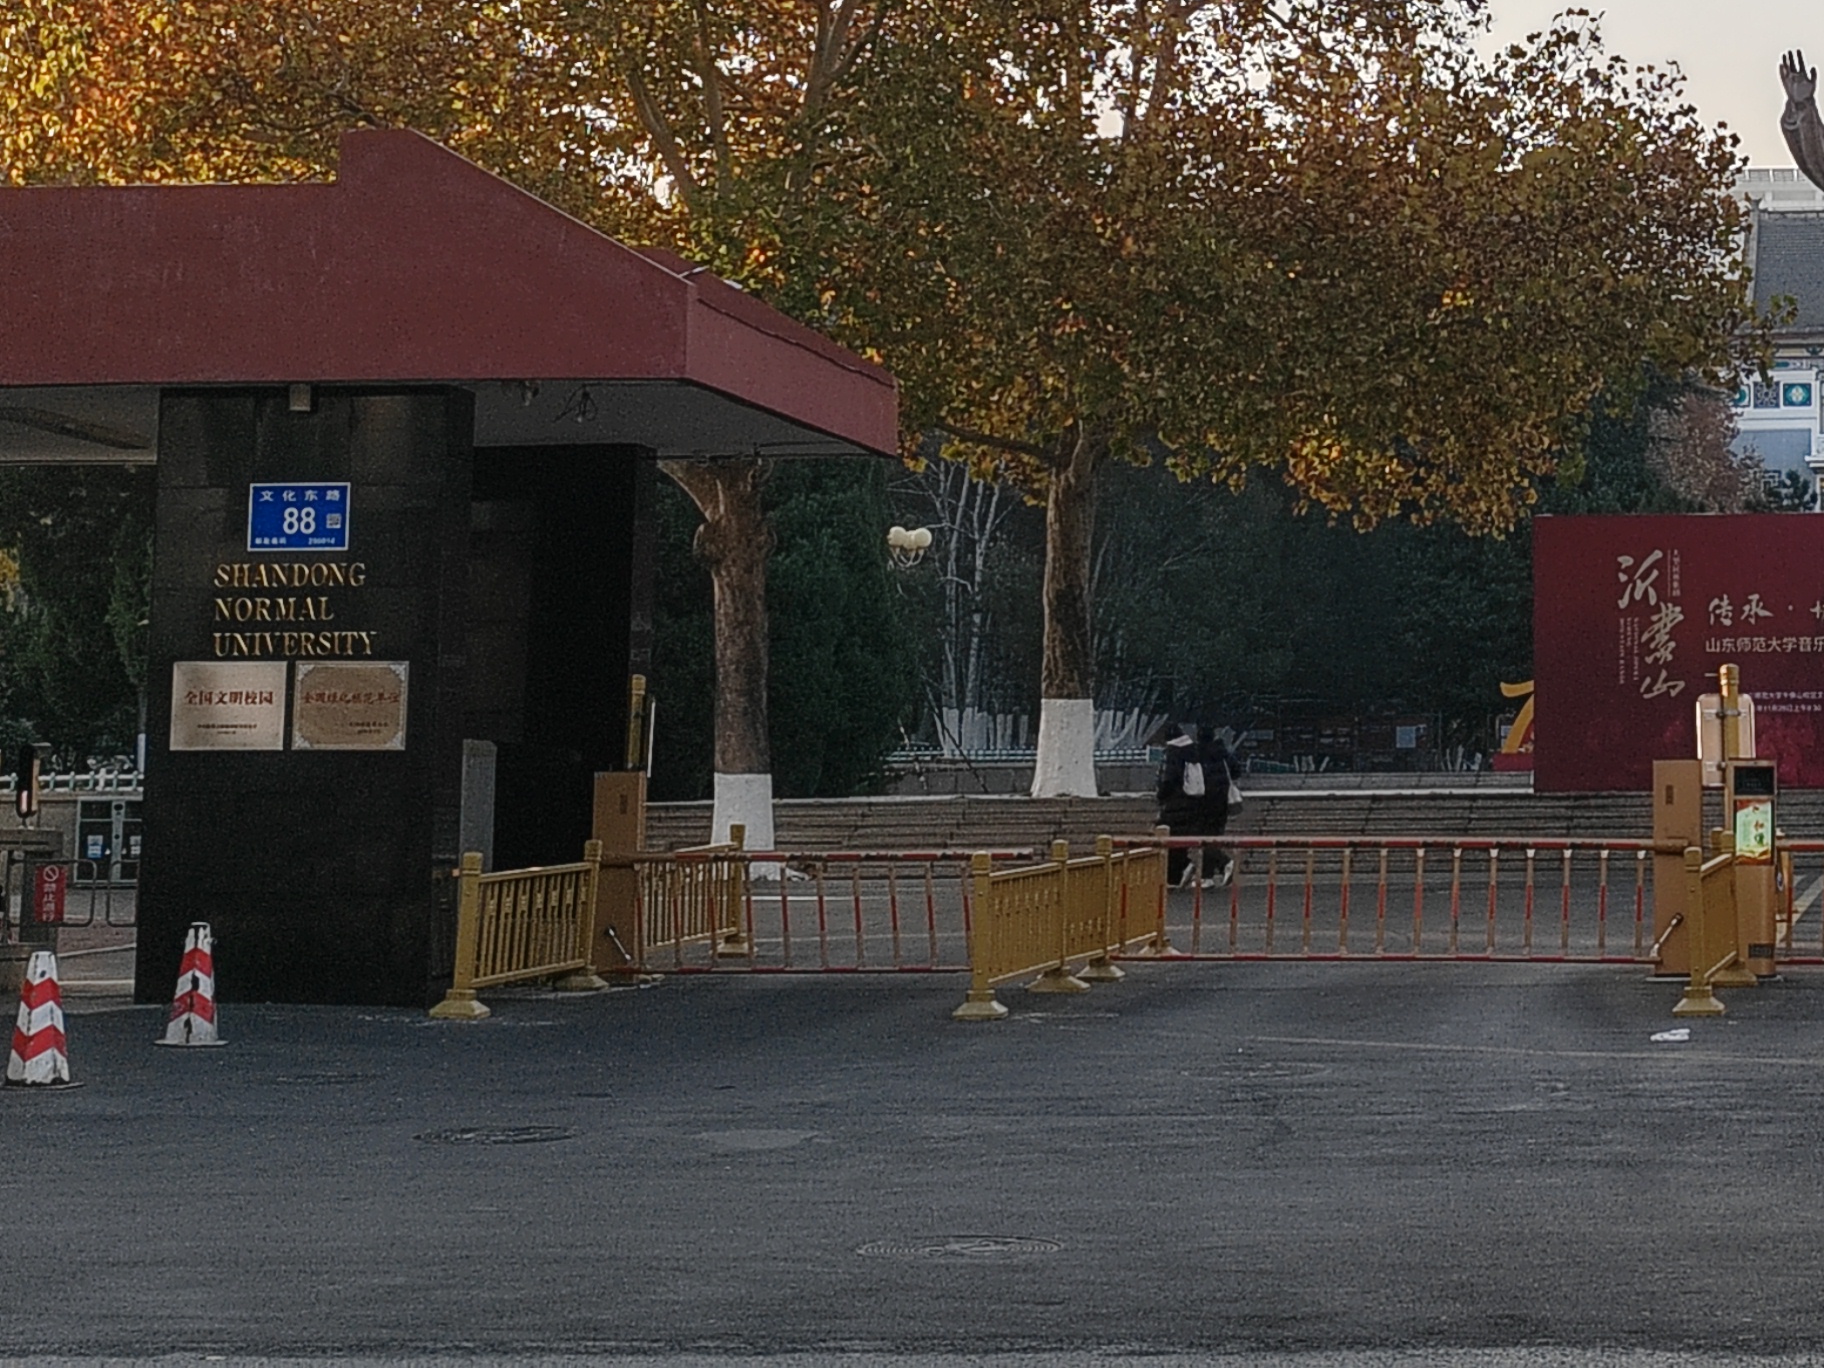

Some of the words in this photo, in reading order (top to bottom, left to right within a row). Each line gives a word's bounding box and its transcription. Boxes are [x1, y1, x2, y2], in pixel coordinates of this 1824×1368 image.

[259, 489, 340, 502] 文化东路
[283, 507, 316, 534] 88
[214, 563, 366, 587] SHANDONG
[214, 596, 335, 621] NORMAL
[213, 631, 377, 657] UNIVERSITY
[185, 691, 273, 706] 全国文明校园
